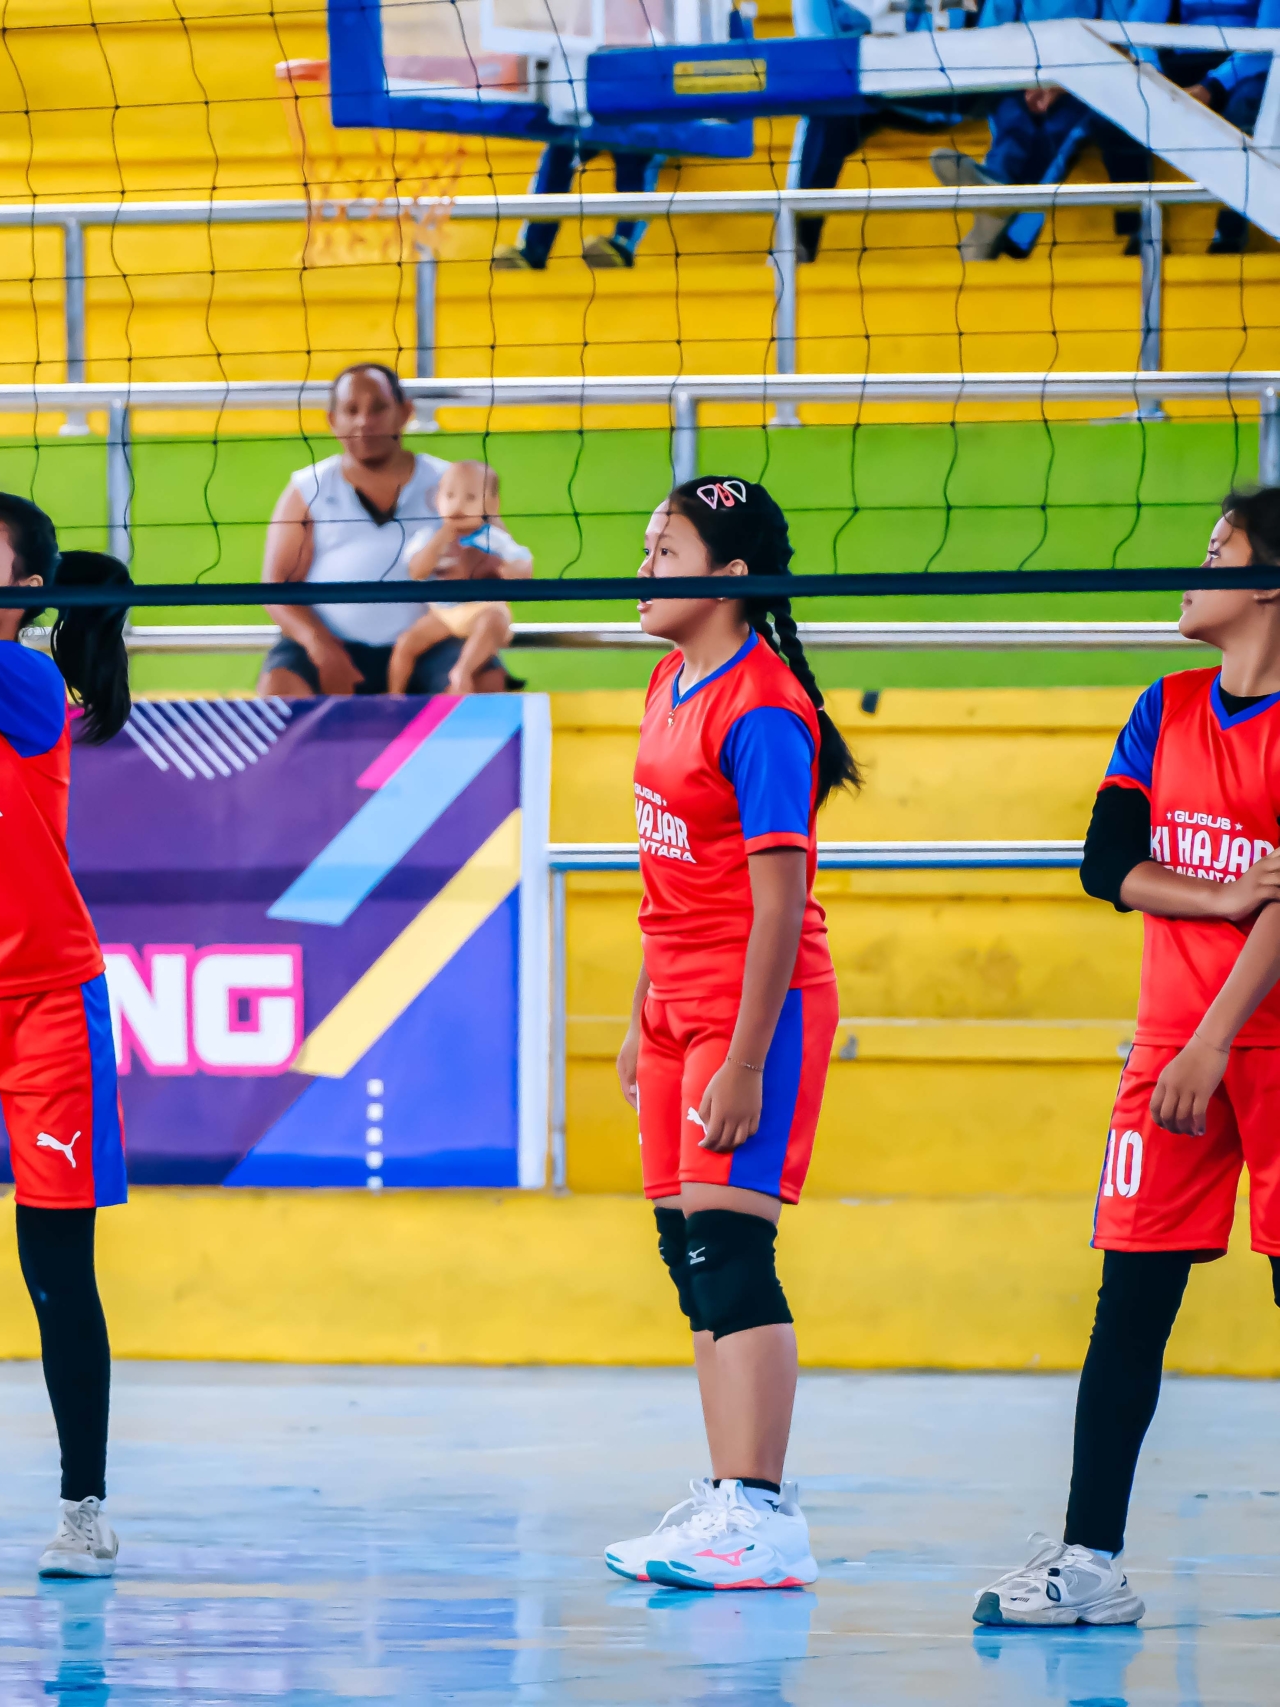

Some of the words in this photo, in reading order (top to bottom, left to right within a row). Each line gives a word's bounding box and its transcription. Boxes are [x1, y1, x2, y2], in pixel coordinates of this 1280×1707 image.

[1174, 810, 1231, 831] GUGUS
[1150, 825, 1171, 862] KI
[1103, 1128, 1143, 1198] 10
